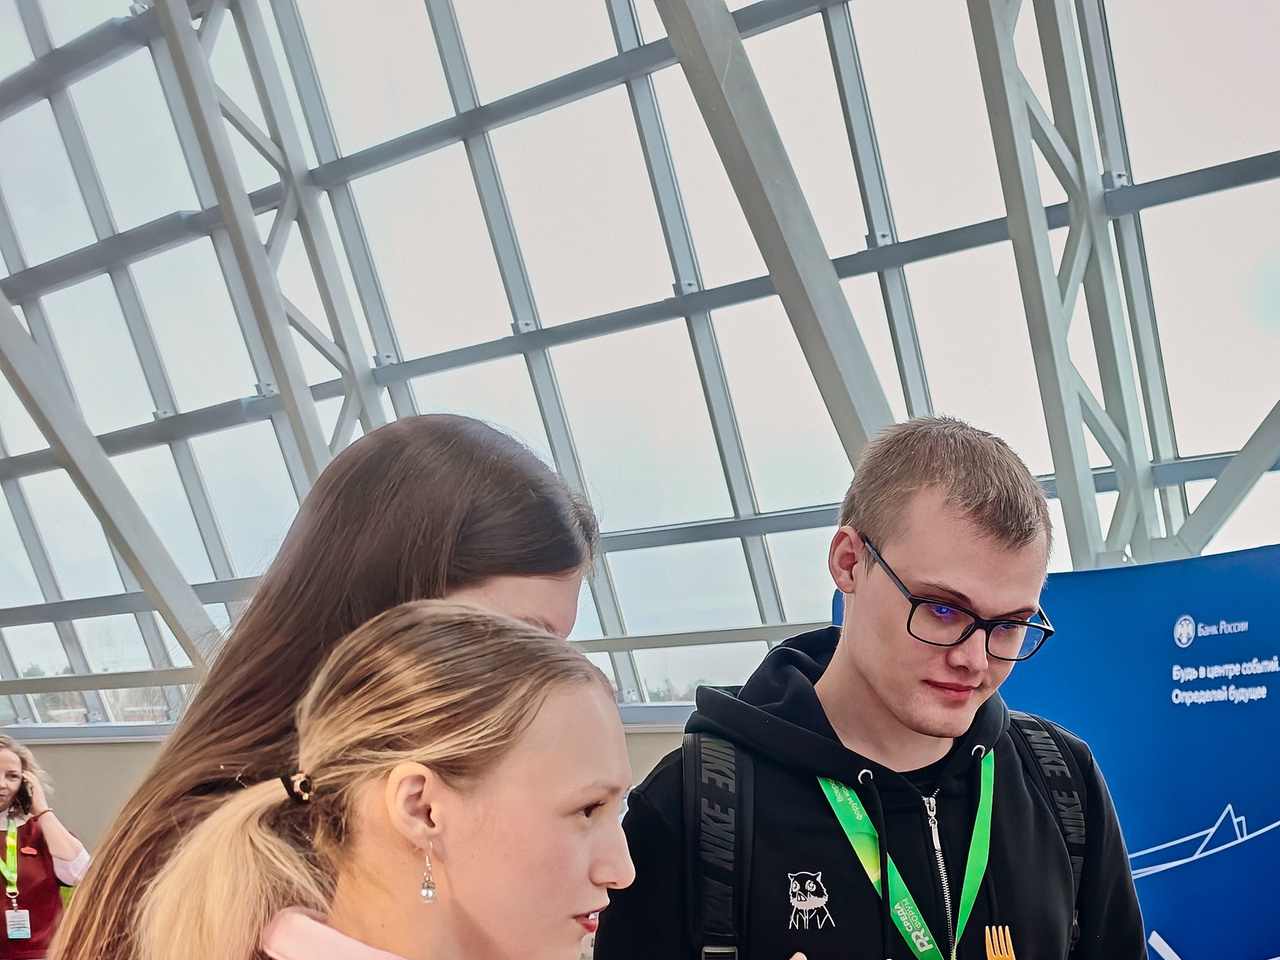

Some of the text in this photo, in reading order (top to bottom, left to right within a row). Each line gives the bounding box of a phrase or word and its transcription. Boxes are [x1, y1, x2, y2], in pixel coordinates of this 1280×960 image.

[1197, 620, 1249, 637] Банк России
[1172, 664, 1198, 683] Будь
[1198, 666, 1206, 679] в
[1206, 663, 1241, 680] центре
[1171, 684, 1268, 706] Определяй будущее
[701, 736, 736, 794] NIKE
[1022, 728, 1072, 779] NIKE
[1052, 790, 1086, 845] NIKE
[701, 797, 735, 872] NIKE
[894, 902, 913, 932] СРЕДА
[902, 897, 922, 929] ФОРУМ
